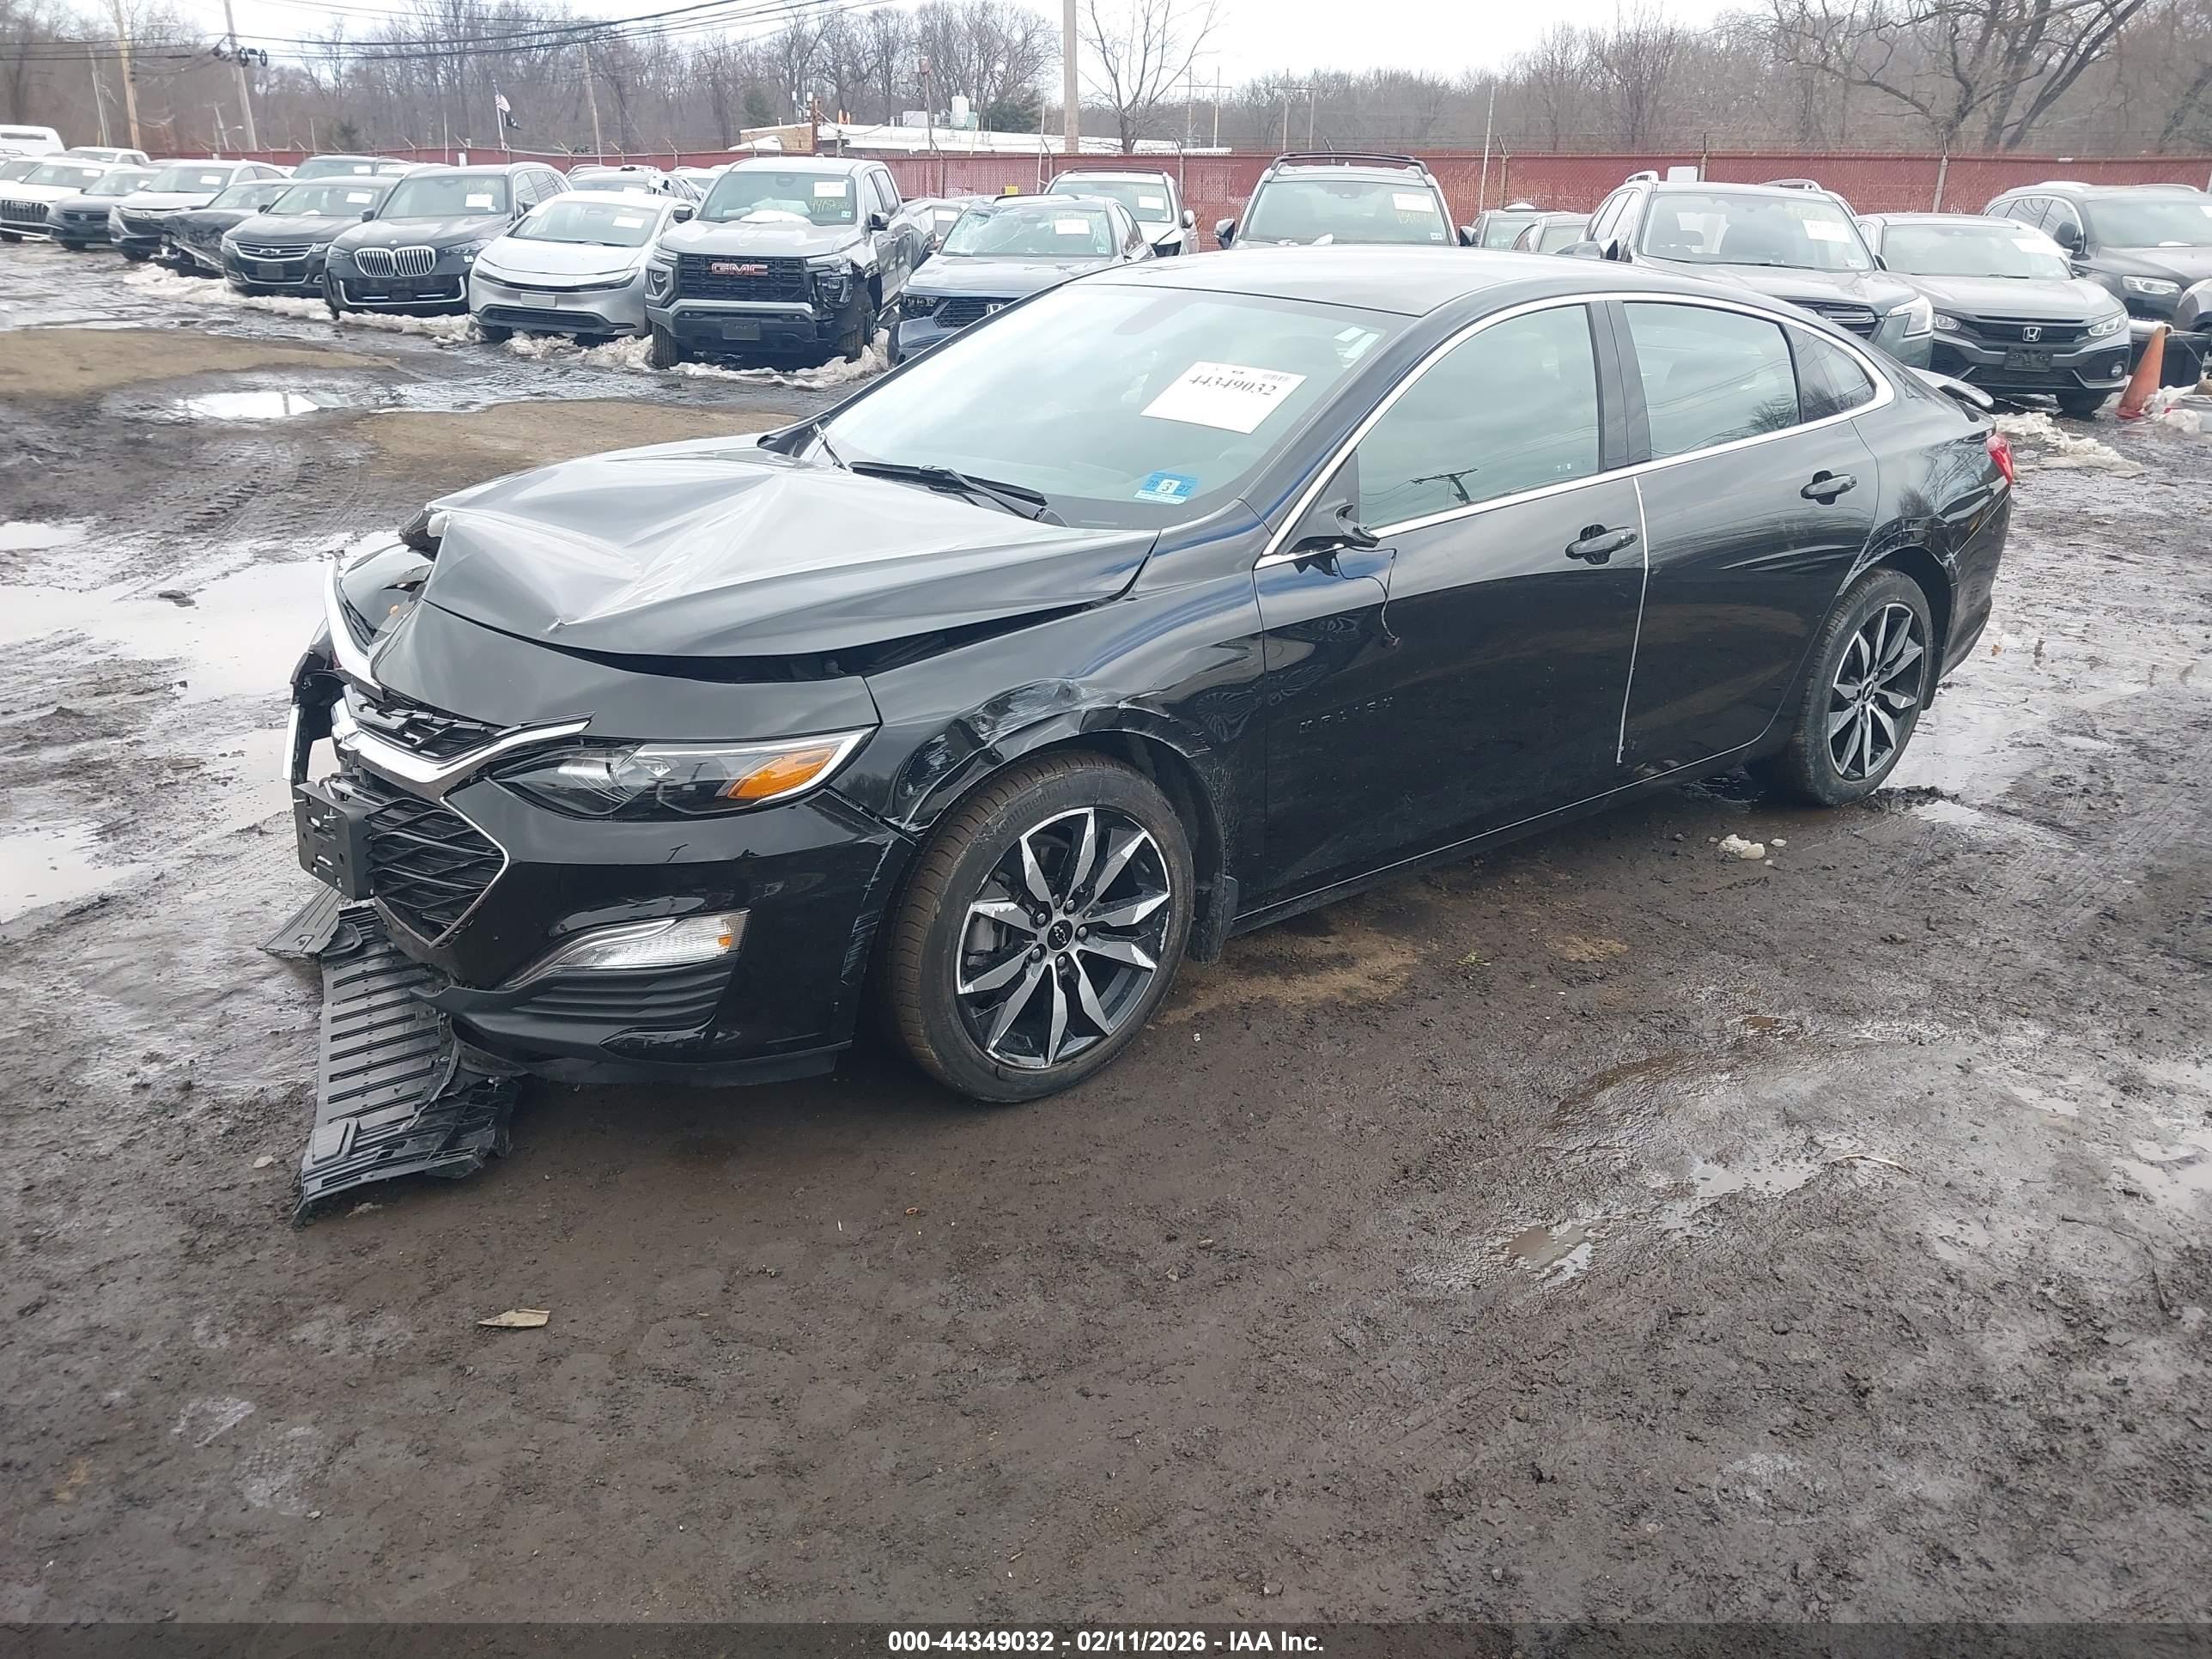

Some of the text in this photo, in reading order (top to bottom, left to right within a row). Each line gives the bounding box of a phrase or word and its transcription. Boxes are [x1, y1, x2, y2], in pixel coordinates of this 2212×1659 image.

[711, 263, 768, 276] GMC
[1188, 374, 1278, 397] 44349032
[1161, 482, 1173, 492] 3
